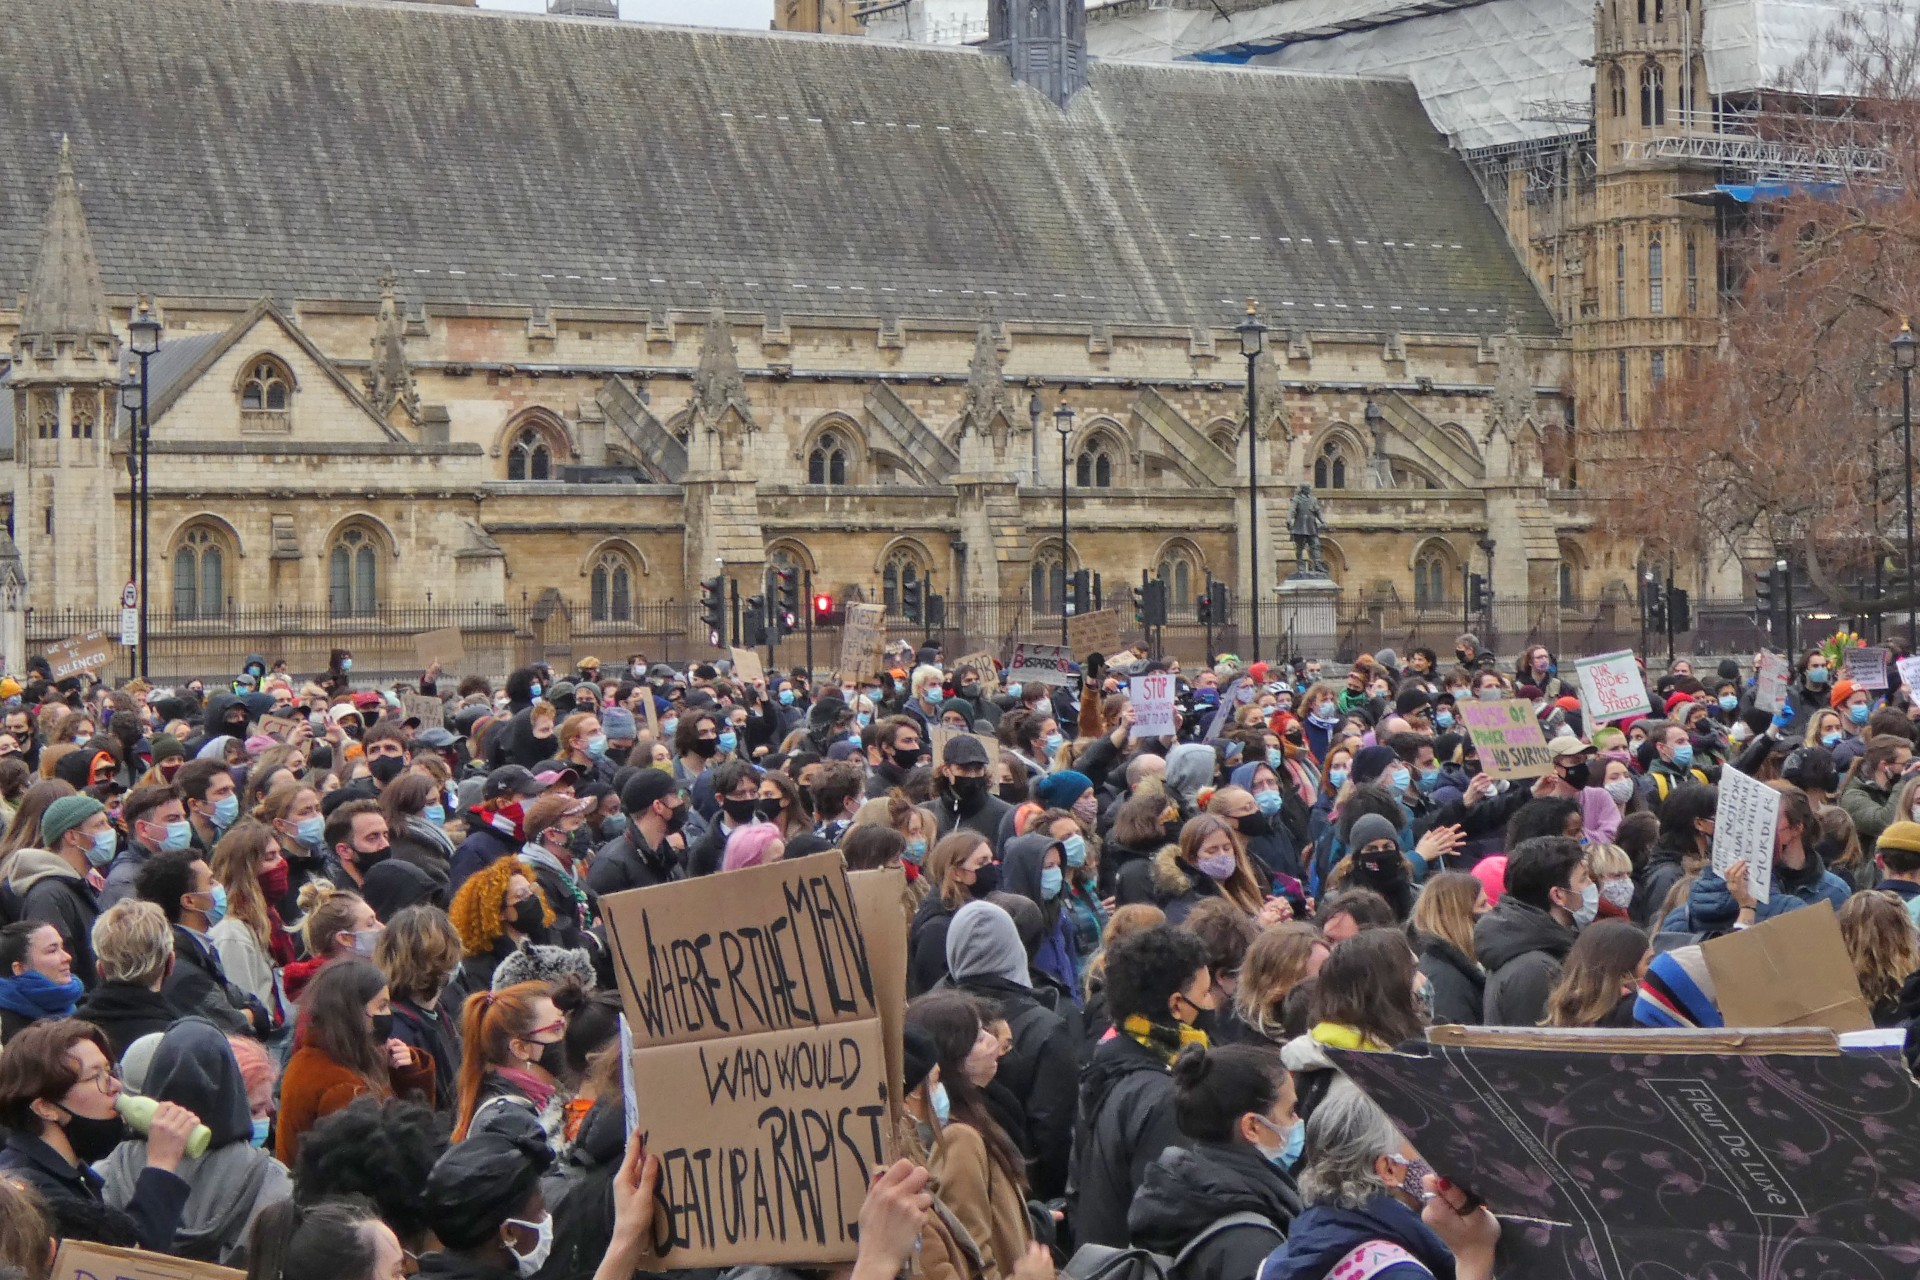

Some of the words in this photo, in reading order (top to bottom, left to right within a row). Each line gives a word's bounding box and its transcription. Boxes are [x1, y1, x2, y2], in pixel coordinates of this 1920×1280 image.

[47, 644, 60, 655] WE
[63, 640, 81, 649] WILL
[69, 648, 79, 657] BE
[57, 652, 105, 677] SILENCED
[1590, 663, 1611, 677] OUR
[1144, 677, 1167, 700] STOP
[1593, 673, 1629, 690] BODIES
[1598, 688, 1618, 703] OUR
[1603, 694, 1640, 713] STREETS
[1509, 706, 1526, 723] OF
[1473, 729, 1506, 746] POWER
[1491, 748, 1510, 767] NO
[1725, 803, 1737, 836] NOT
[1756, 796, 1774, 885] MURDER
[608, 907, 730, 1038] WHERE
[737, 917, 812, 1031] THE
[782, 867, 877, 1031] MEN
[699, 1045, 772, 1106] WHO
[774, 1038, 862, 1092] WOULD
[1678, 1088, 1730, 1131] Fleur
[1718, 1135, 1751, 1158] De
[1740, 1162, 1787, 1205] Luxe
[719, 1147, 748, 1245] UP
[754, 1147, 775, 1242] A
